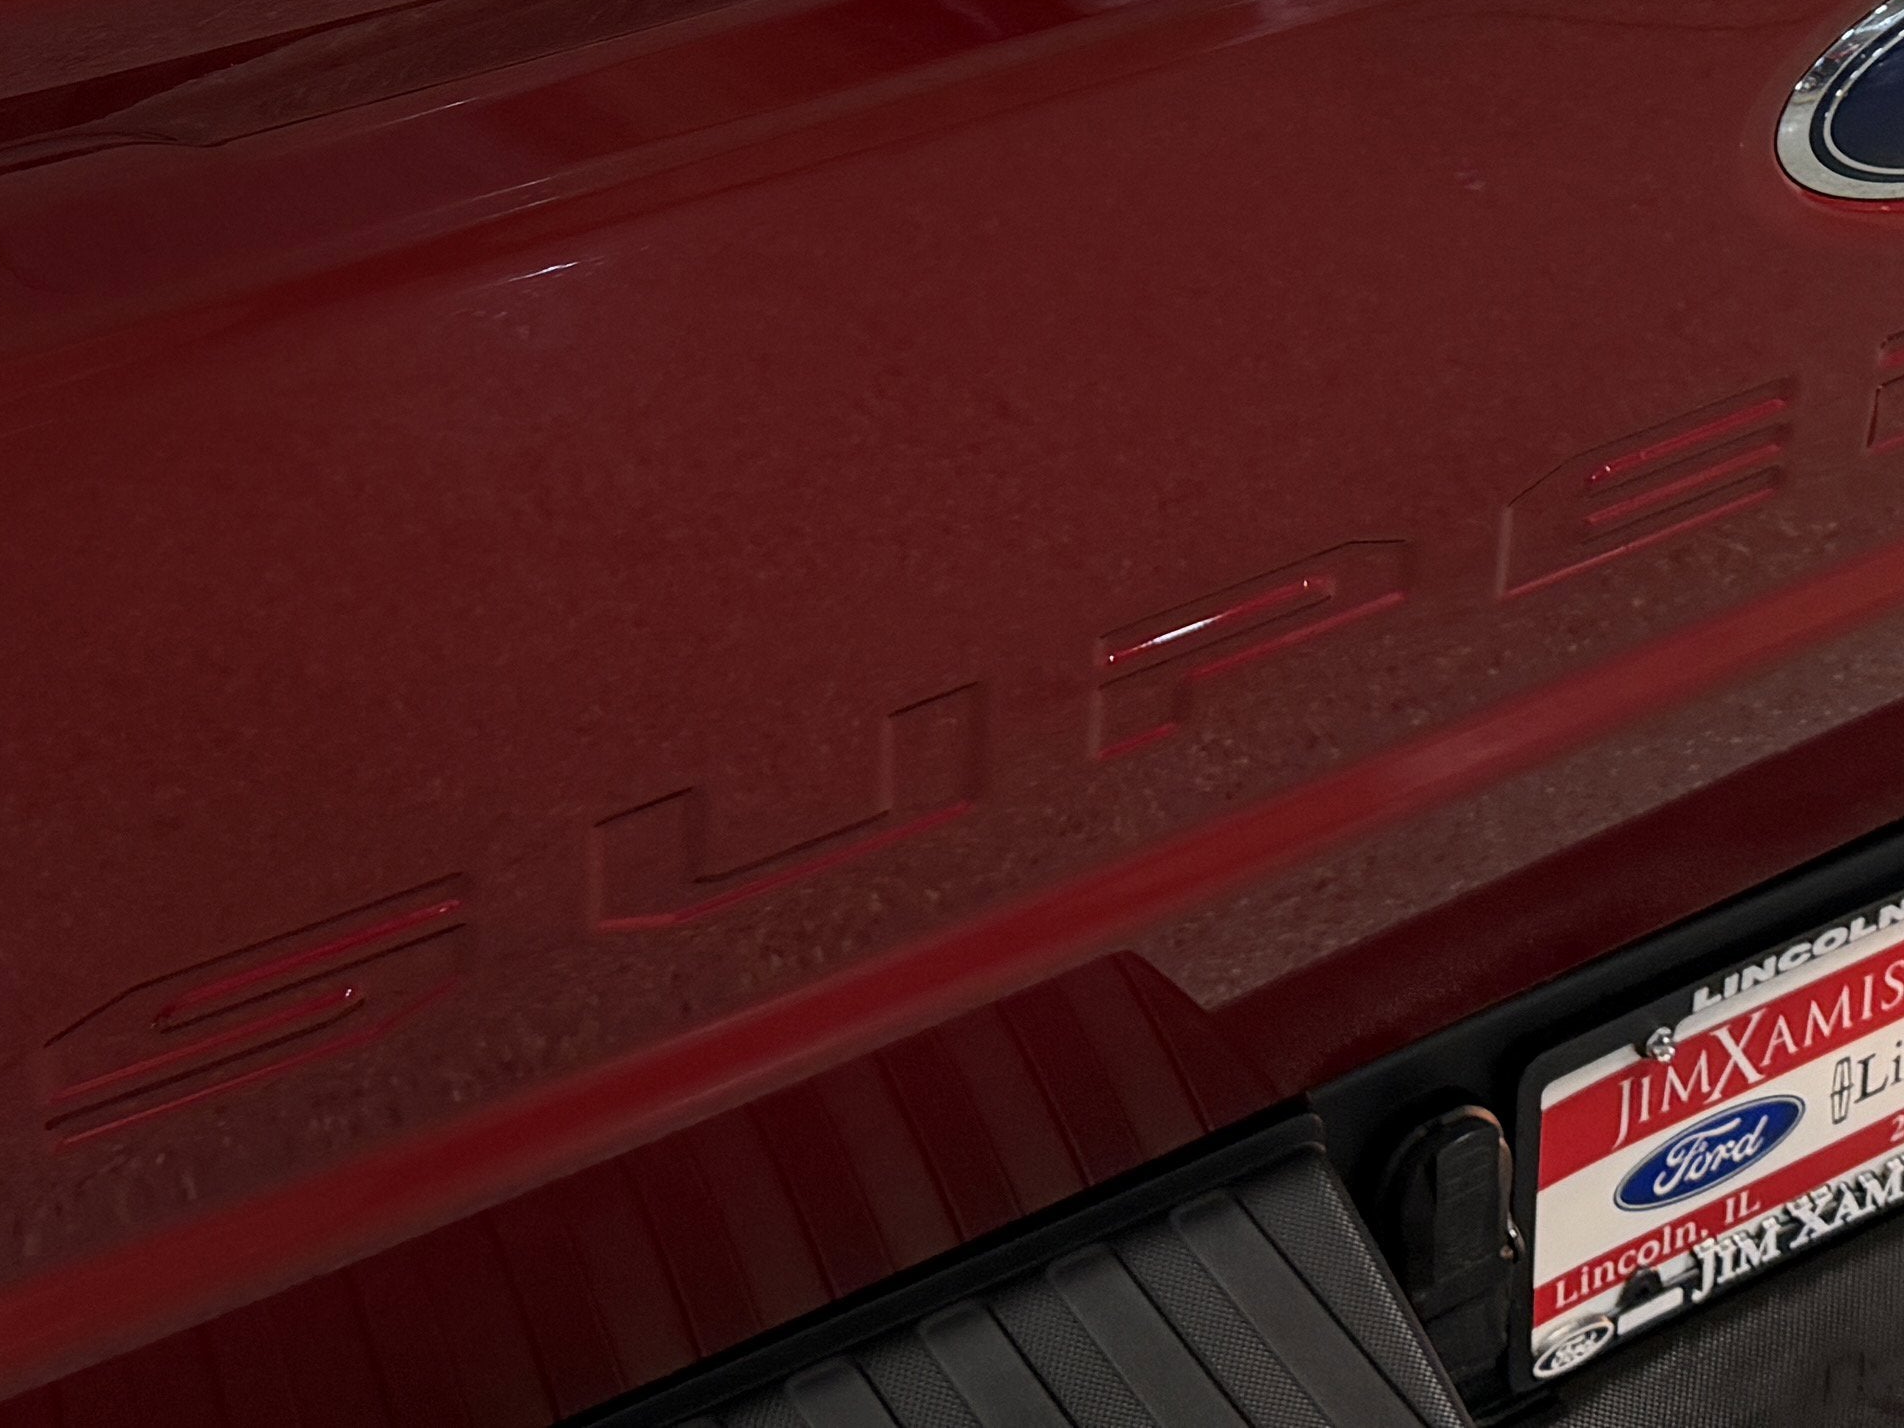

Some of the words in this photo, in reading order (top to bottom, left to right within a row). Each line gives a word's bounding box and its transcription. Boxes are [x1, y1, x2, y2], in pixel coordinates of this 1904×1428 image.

[1653, 1115, 1769, 1197] Ford
[1555, 1221, 1709, 1308] Lincoln,
[1724, 1191, 1761, 1224] IL
[1692, 1217, 1780, 1303] JIM
